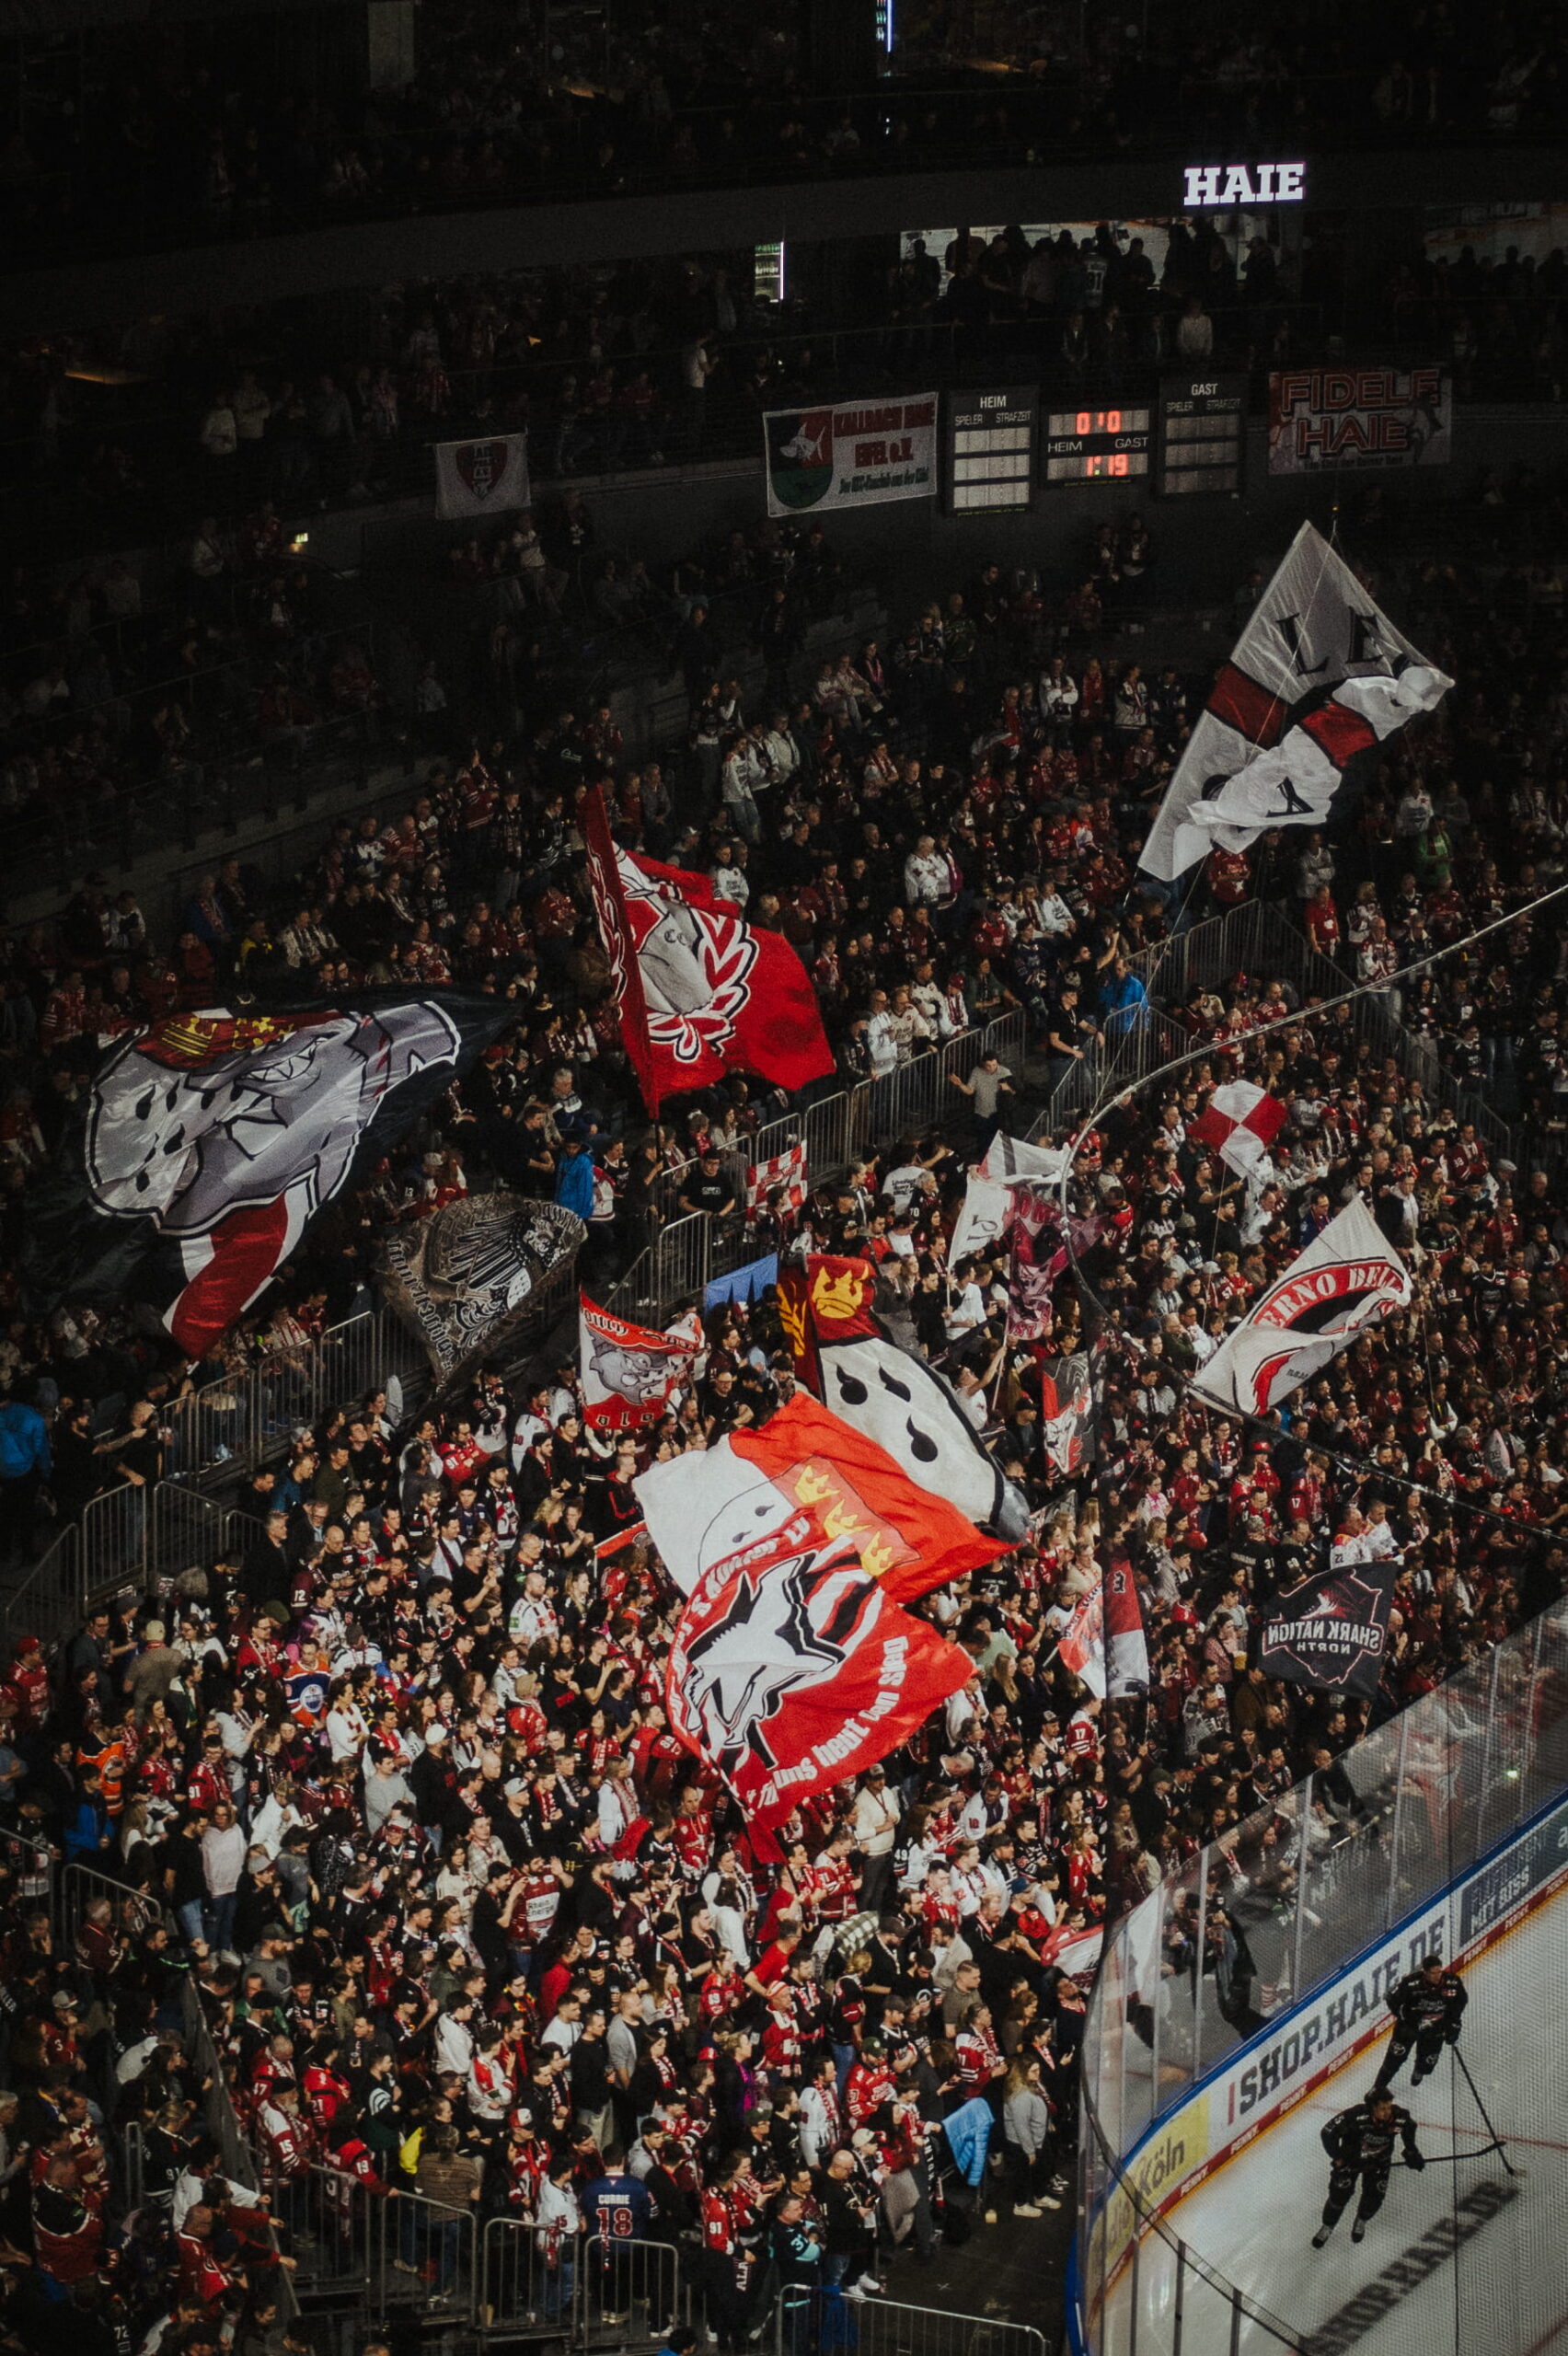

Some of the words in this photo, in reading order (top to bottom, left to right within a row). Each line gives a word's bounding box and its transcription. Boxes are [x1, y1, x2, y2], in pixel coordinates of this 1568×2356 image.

[1183, 164, 1304, 205] HAIE
[1191, 383, 1218, 396] GAST
[1281, 368, 1441, 413] FIDELE
[979, 396, 1007, 409] HEIM
[1166, 401, 1193, 412] SPIELER
[954, 413, 983, 426] SPIELER
[996, 410, 1032, 423] STRAFZEIT
[1297, 413, 1409, 456] HAIE
[1047, 440, 1083, 454] HEIM
[1114, 436, 1148, 450] GAST
[1292, 1497, 1301, 1508] 17
[294, 1589, 306, 1602] 12
[1075, 1727, 1086, 1739] 17
[773, 1757, 818, 1789] uns
[811, 1717, 870, 1767] heut
[189, 1785, 201, 1799] 91
[894, 1848, 908, 1861] 49
[1239, 1919, 1445, 2115] SHOP.HAIEDE
[1374, 2015, 1398, 2038] PENN
[1327, 2047, 1355, 2078] PENNY
[1279, 2085, 1308, 2116] PENNY
[279, 2139, 294, 2154] 15
[1230, 2123, 1260, 2155] PENNY
[356, 2160, 369, 2175] 19
[1138, 2137, 1185, 2197] Köln
[1180, 2166, 1209, 2198] PENNY
[596, 2207, 633, 2236] 18
[709, 2222, 722, 2235] 91
[113, 2325, 130, 2339] 72
